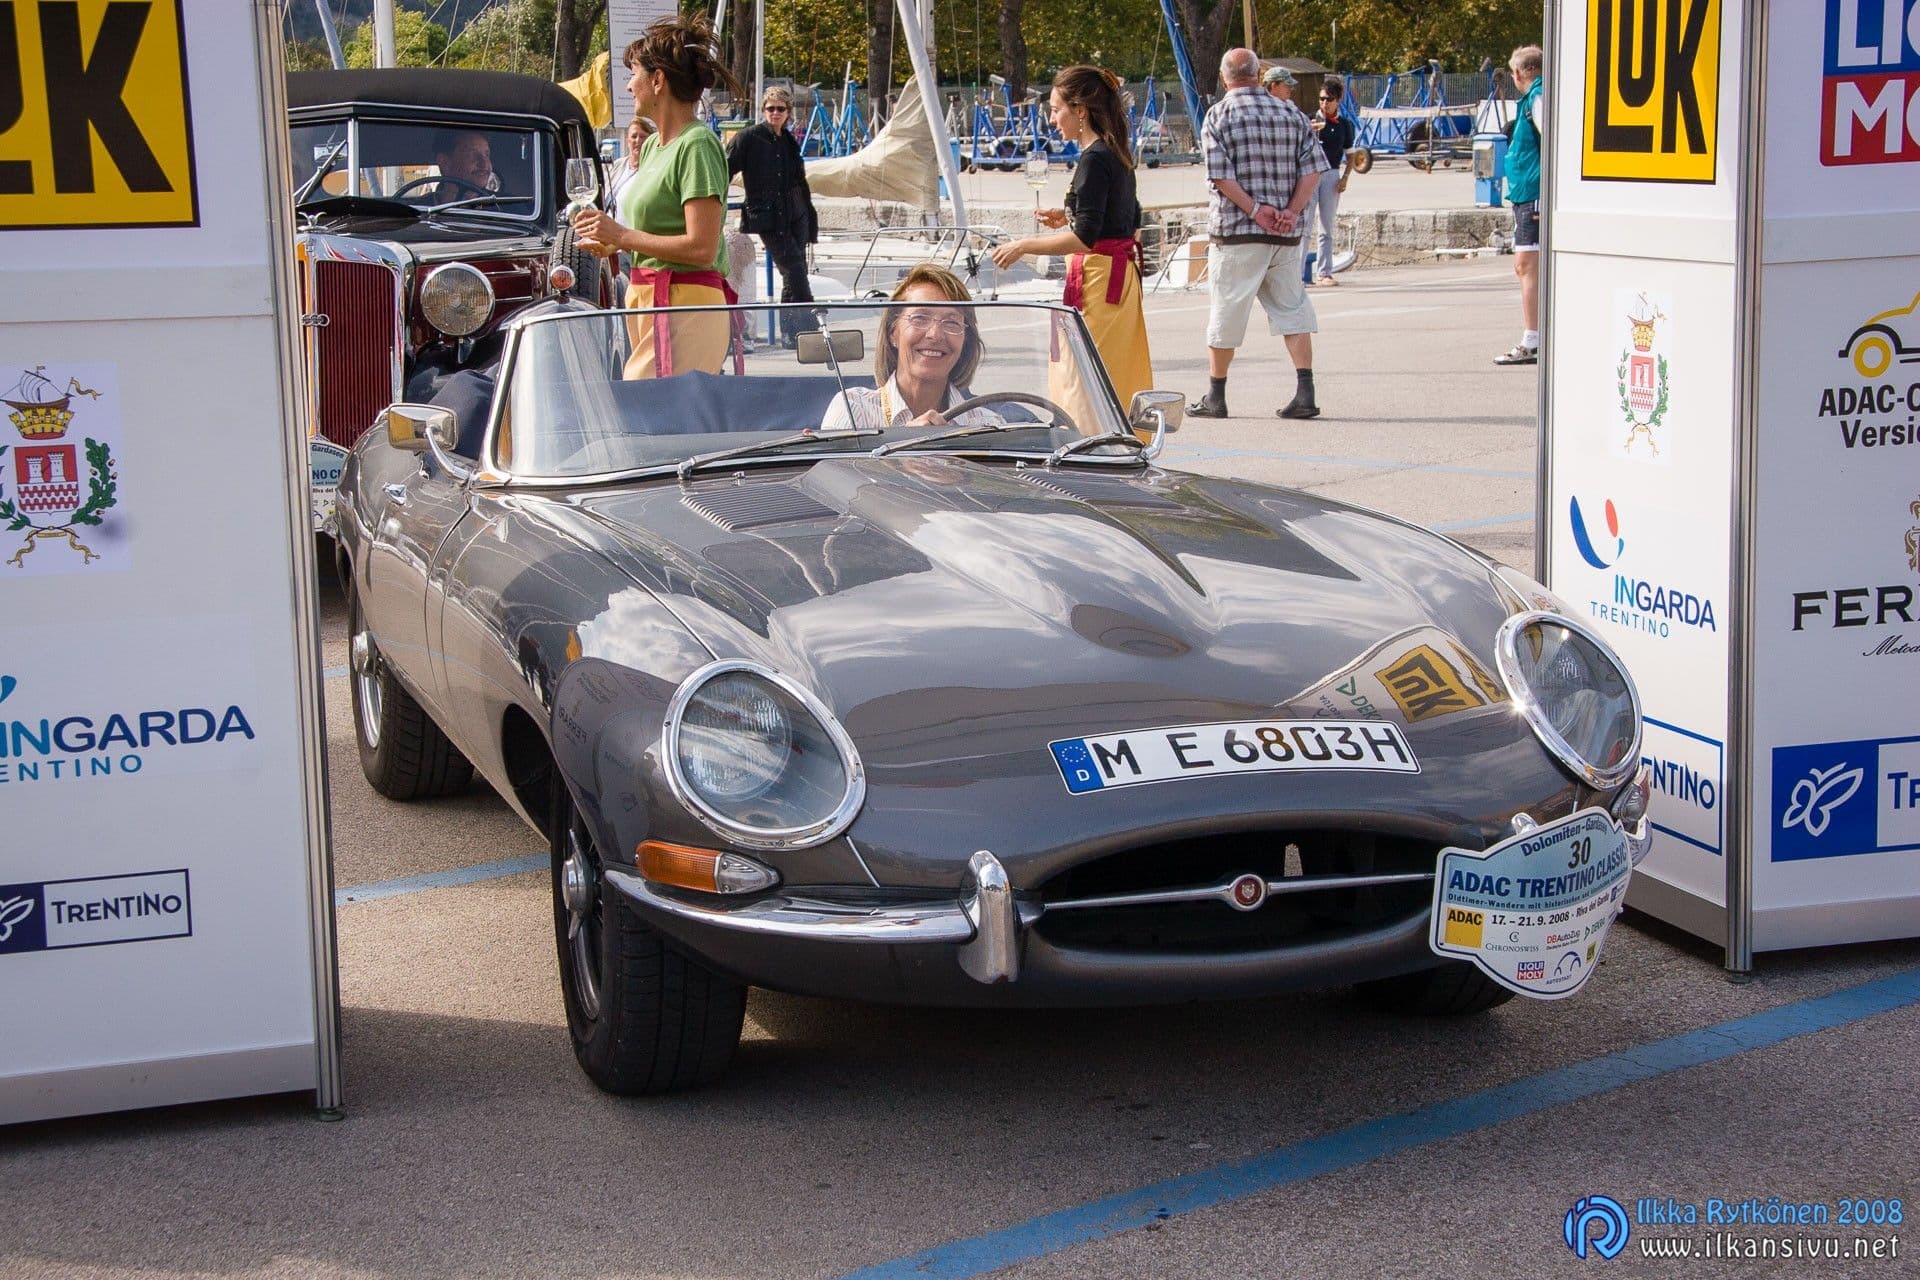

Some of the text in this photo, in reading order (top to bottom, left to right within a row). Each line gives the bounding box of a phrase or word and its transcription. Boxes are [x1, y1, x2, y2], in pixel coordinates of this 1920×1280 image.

[1840, 415, 1920, 448] Versi
[1590, 601, 1669, 638] TRENTINO
[1615, 574, 1716, 632] INGARDA
[1791, 583, 1920, 631] FER
[1092, 726, 1408, 778] M E 6803H
[1076, 769, 1091, 782] D
[1567, 836, 1591, 869] 30
[1449, 869, 1511, 898] ADAC
[1516, 865, 1596, 899] TRENTINO
[50, 888, 182, 925] TRENTINO
[1447, 909, 1483, 926] ADAC
[1528, 902, 1541, 910] mit
[1548, 911, 1570, 925] 2008
[1518, 971, 1544, 980] MOLY
[1519, 961, 1545, 971] LIQUI
